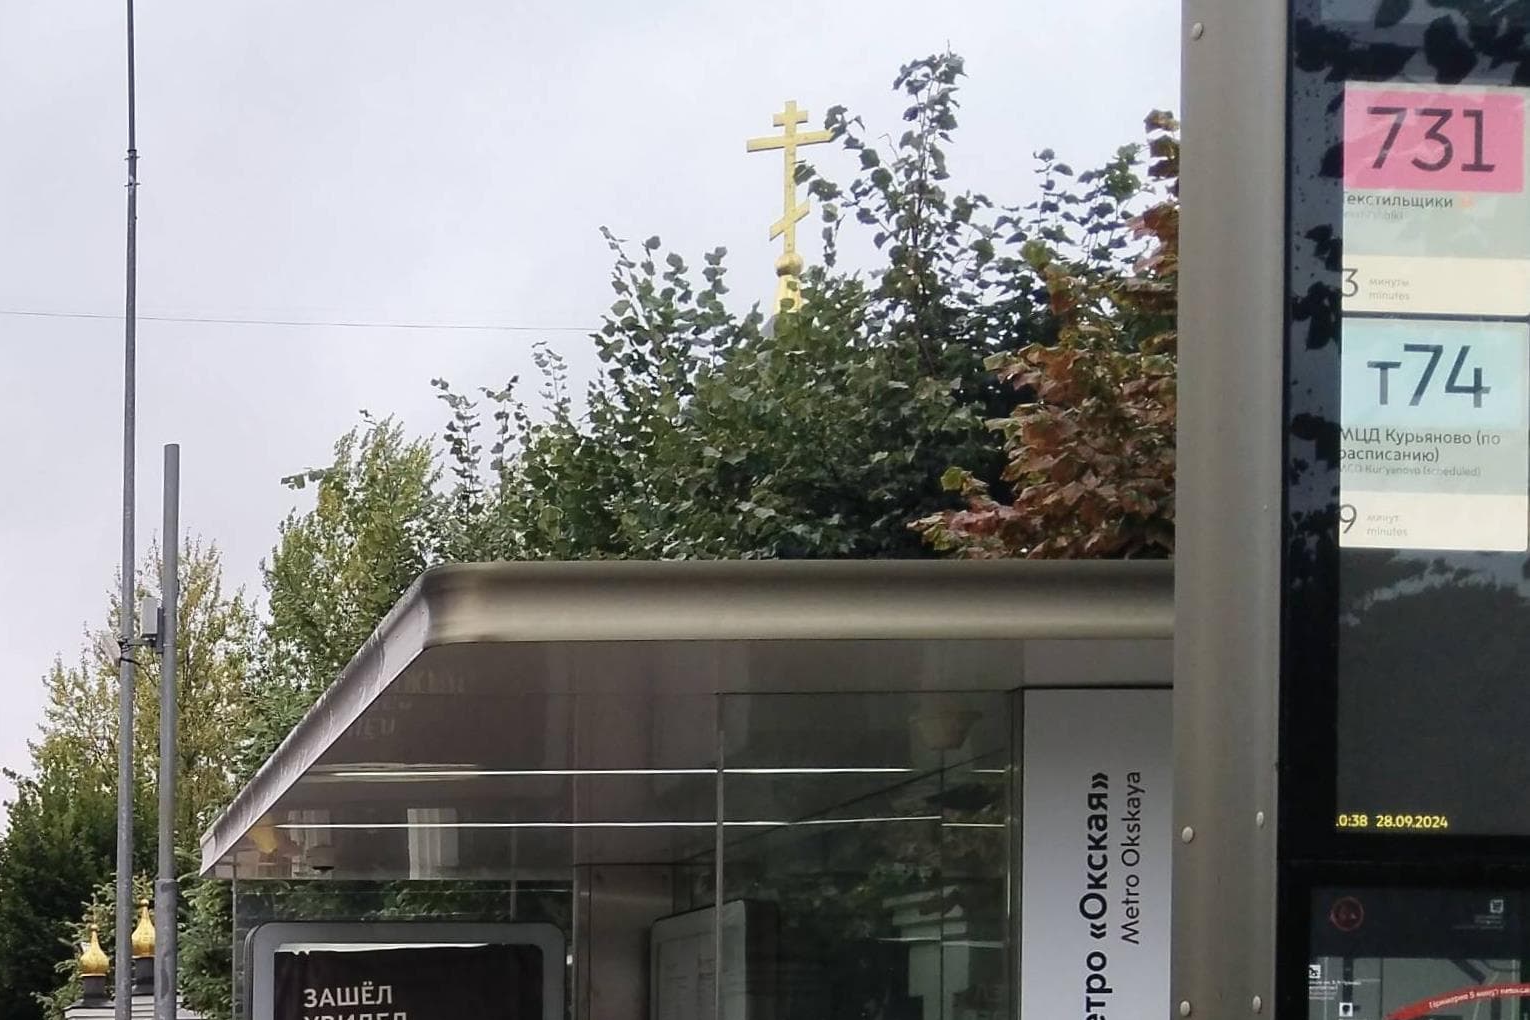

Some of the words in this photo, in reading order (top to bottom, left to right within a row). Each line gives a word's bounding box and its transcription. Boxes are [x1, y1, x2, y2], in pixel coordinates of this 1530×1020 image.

[1367, 106, 1495, 172] 731
[1345, 193, 1454, 209] екстильщики
[1342, 268, 1359, 298] 3
[1369, 291, 1411, 301] minutes
[1385, 428, 1472, 446] Курьяново
[1476, 430, 1501, 446] (по
[1340, 504, 1357, 534] 9
[1121, 771, 1145, 866] Okskaya
[1336, 814, 1368, 827] 0:38
[1376, 815, 1448, 828] 28.09.2024
[1079, 772, 1109, 939] «Окская»
[1121, 874, 1140, 944] Metro
[303, 981, 392, 1008] ЗАШЁЛ
